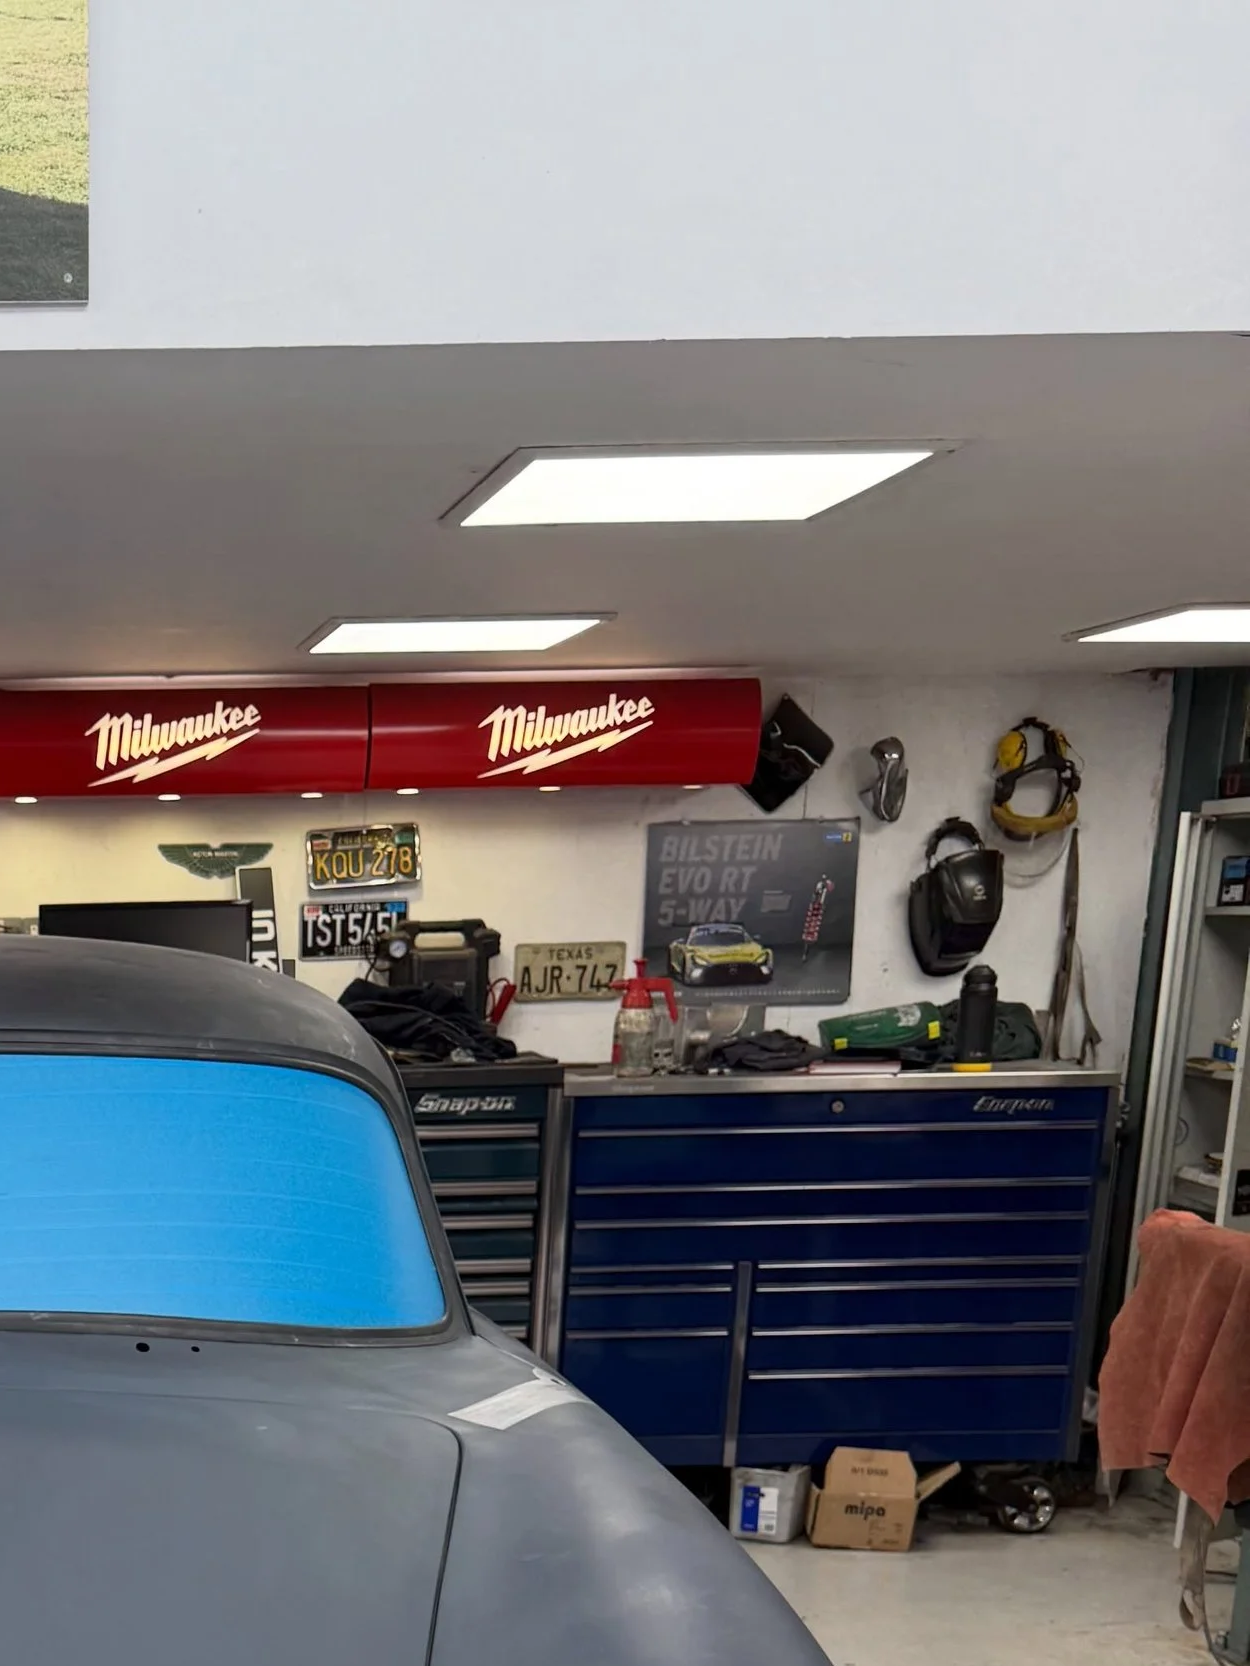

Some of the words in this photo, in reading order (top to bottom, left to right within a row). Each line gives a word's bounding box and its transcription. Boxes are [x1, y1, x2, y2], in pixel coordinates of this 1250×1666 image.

[84, 700, 262, 771] Milwaukee
[477, 693, 655, 762] Milwaukee
[371, 846, 412, 876] 278
[658, 834, 784, 863] BILSTEIN
[658, 866, 713, 895] EVO
[718, 866, 758, 893] RT
[657, 897, 747, 927] 5-WAY
[548, 946, 593, 961] TEXAS
[844, 1501, 886, 1521] mipa
